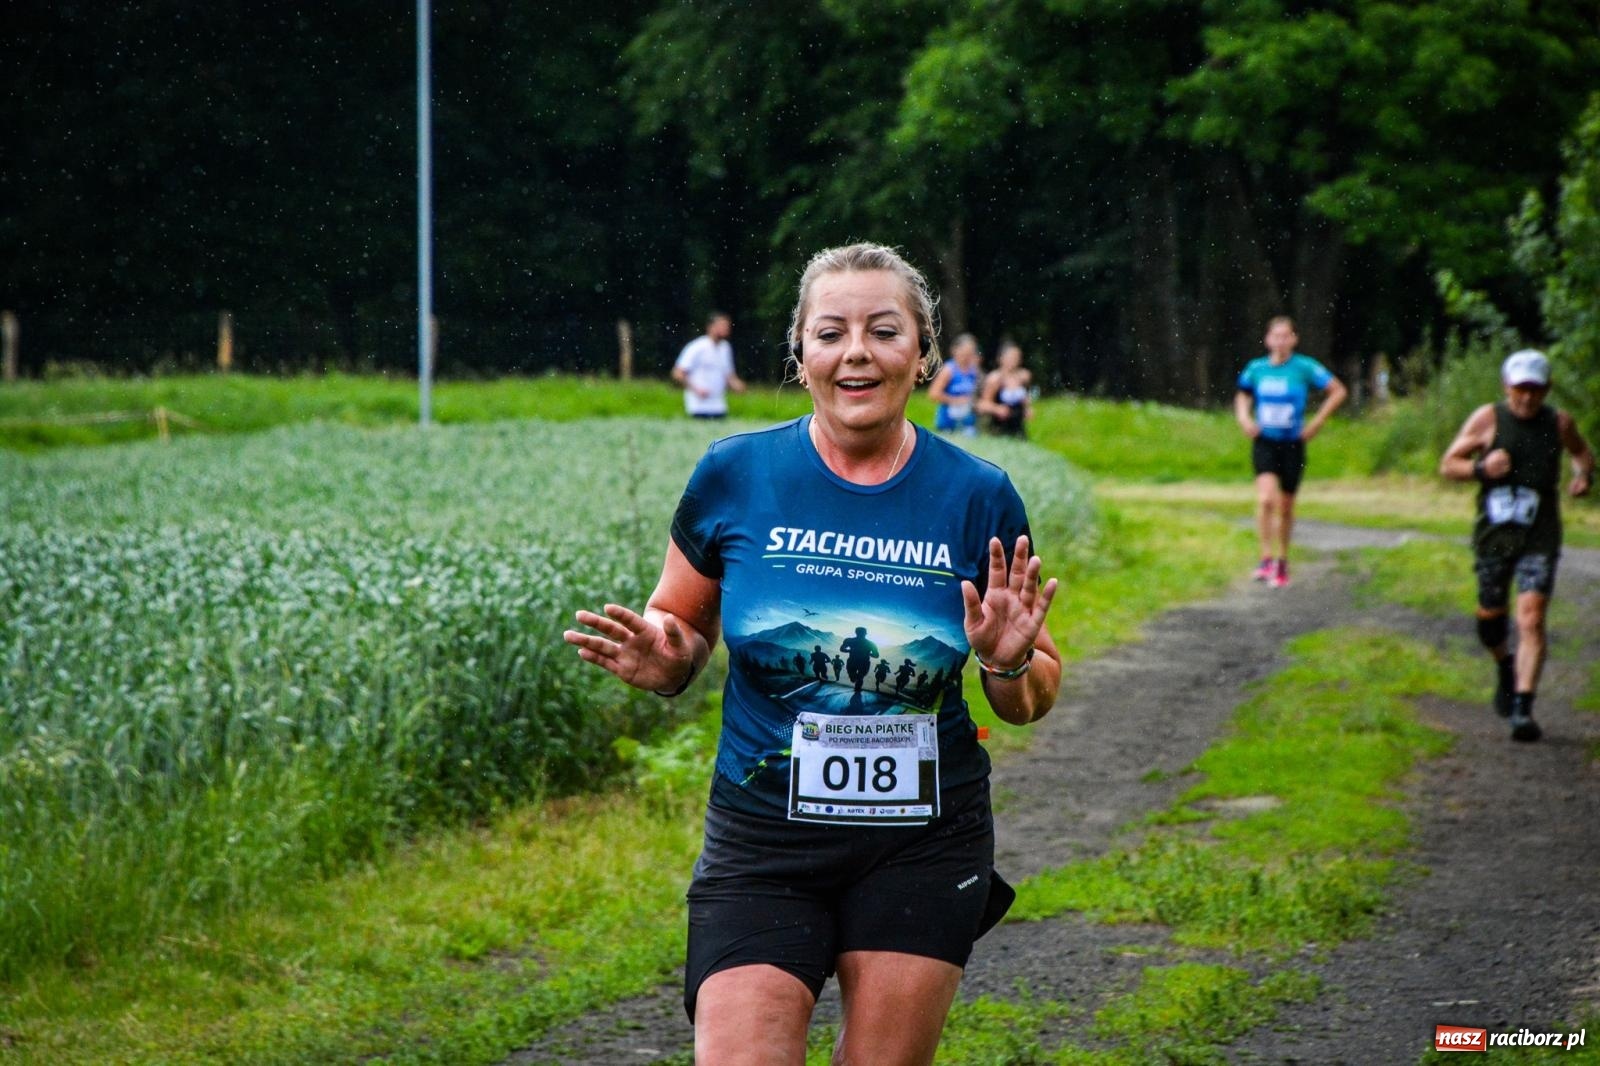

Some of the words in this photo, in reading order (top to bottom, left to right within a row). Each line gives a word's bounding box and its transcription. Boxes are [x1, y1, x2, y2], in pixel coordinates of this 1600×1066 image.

[766, 526, 952, 569] STACHOWNIA
[796, 563, 843, 578] GRUPA
[847, 568, 925, 588] SPORTOWA
[825, 724, 853, 735] BIEG
[855, 724, 873, 734] NA
[875, 723, 914, 735] PIĄTKĘ
[822, 755, 898, 793] 018
